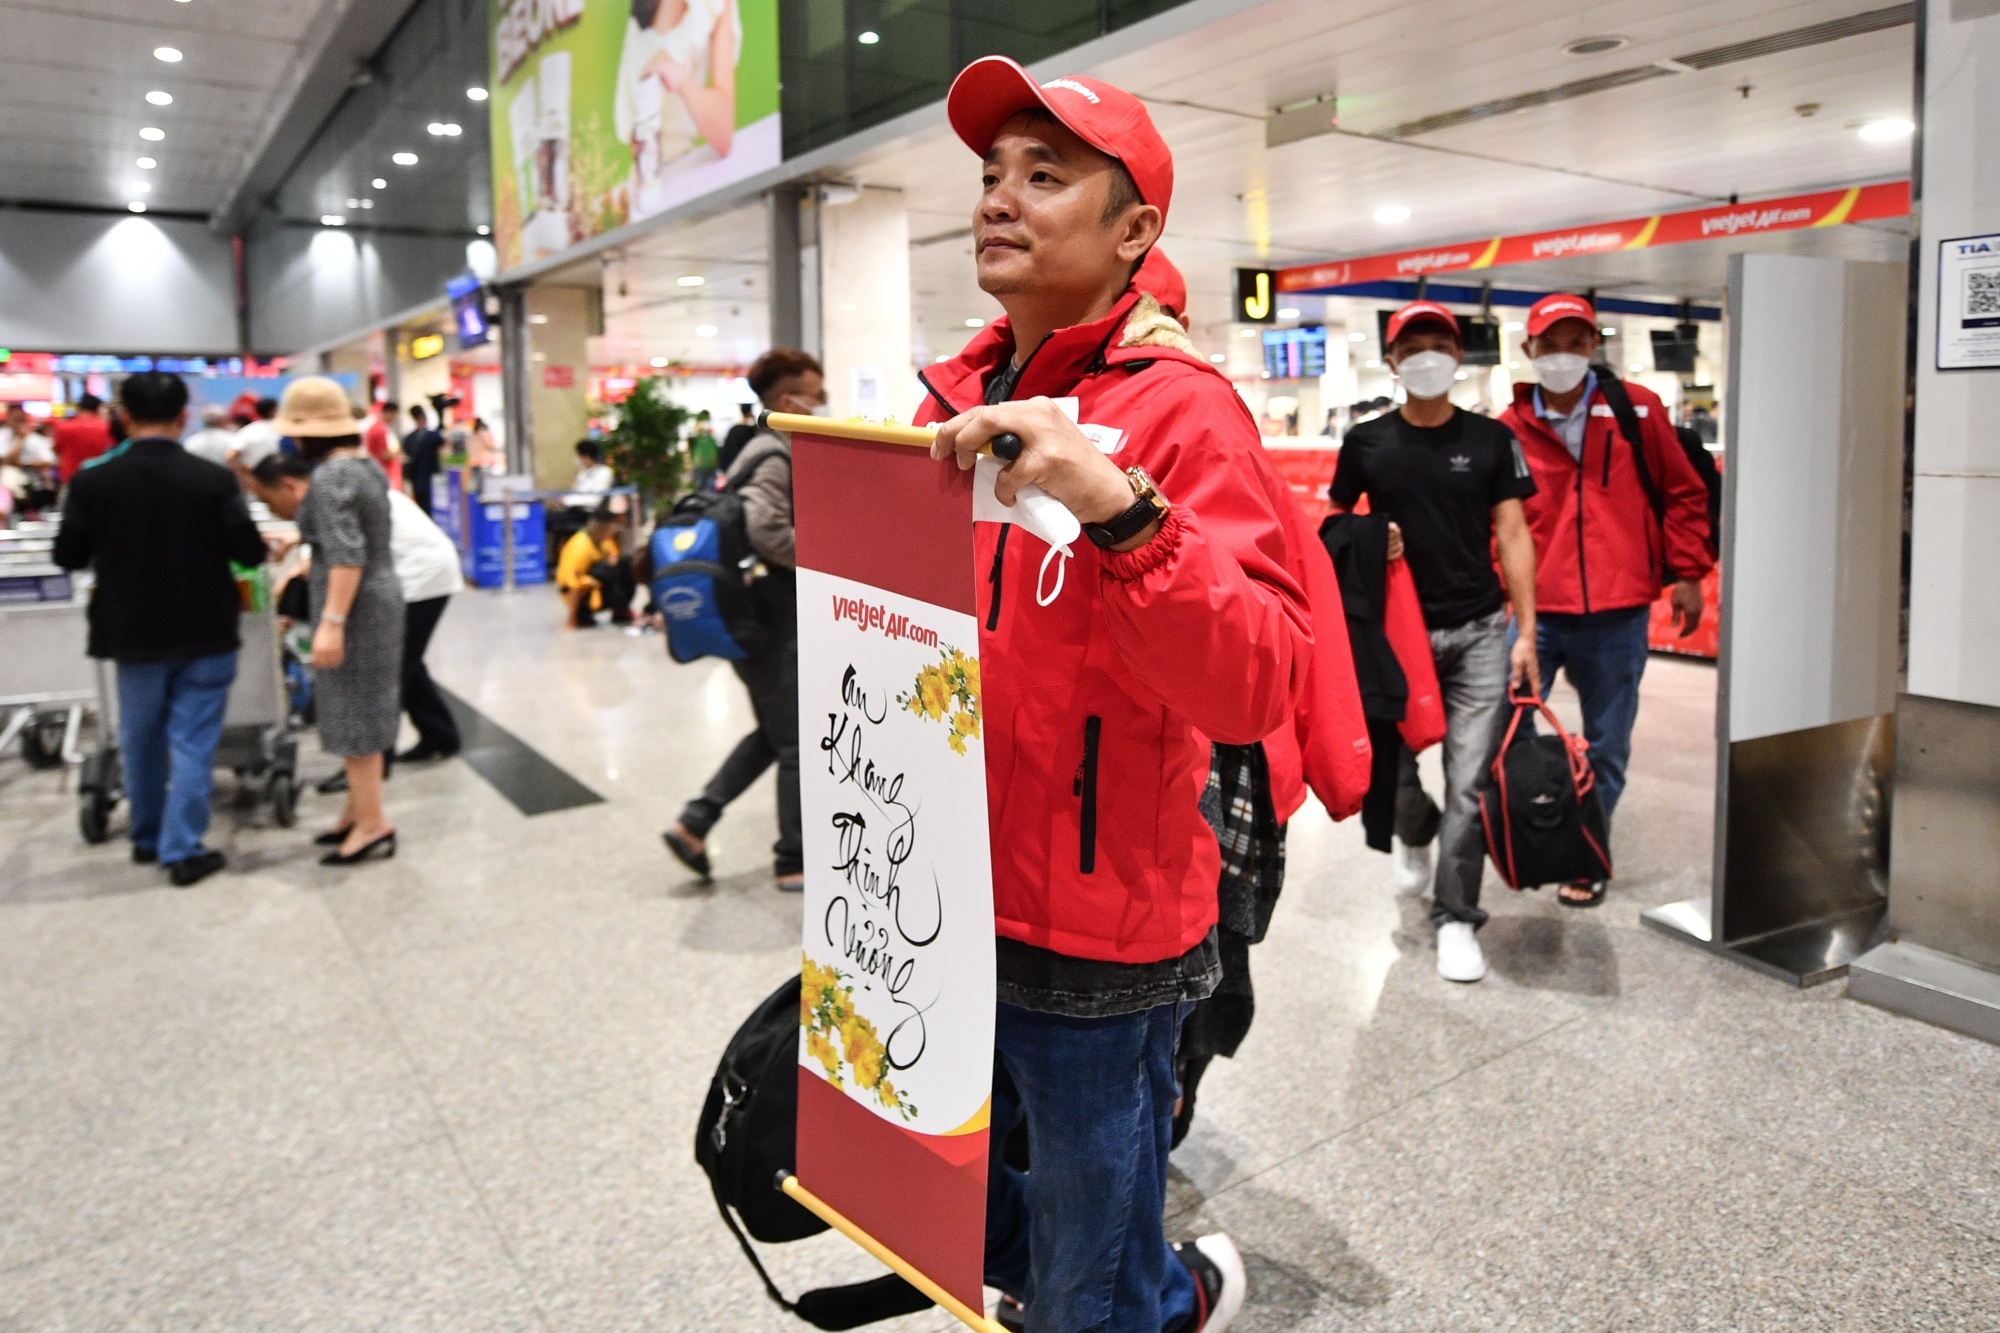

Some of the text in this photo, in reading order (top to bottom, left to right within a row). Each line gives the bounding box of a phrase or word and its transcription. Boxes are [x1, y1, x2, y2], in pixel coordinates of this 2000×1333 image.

[1957, 243, 1990, 254] TIA
[1245, 272, 1270, 319] J
[820, 712, 923, 865] Khang
[831, 811, 943, 947] Thịnh
